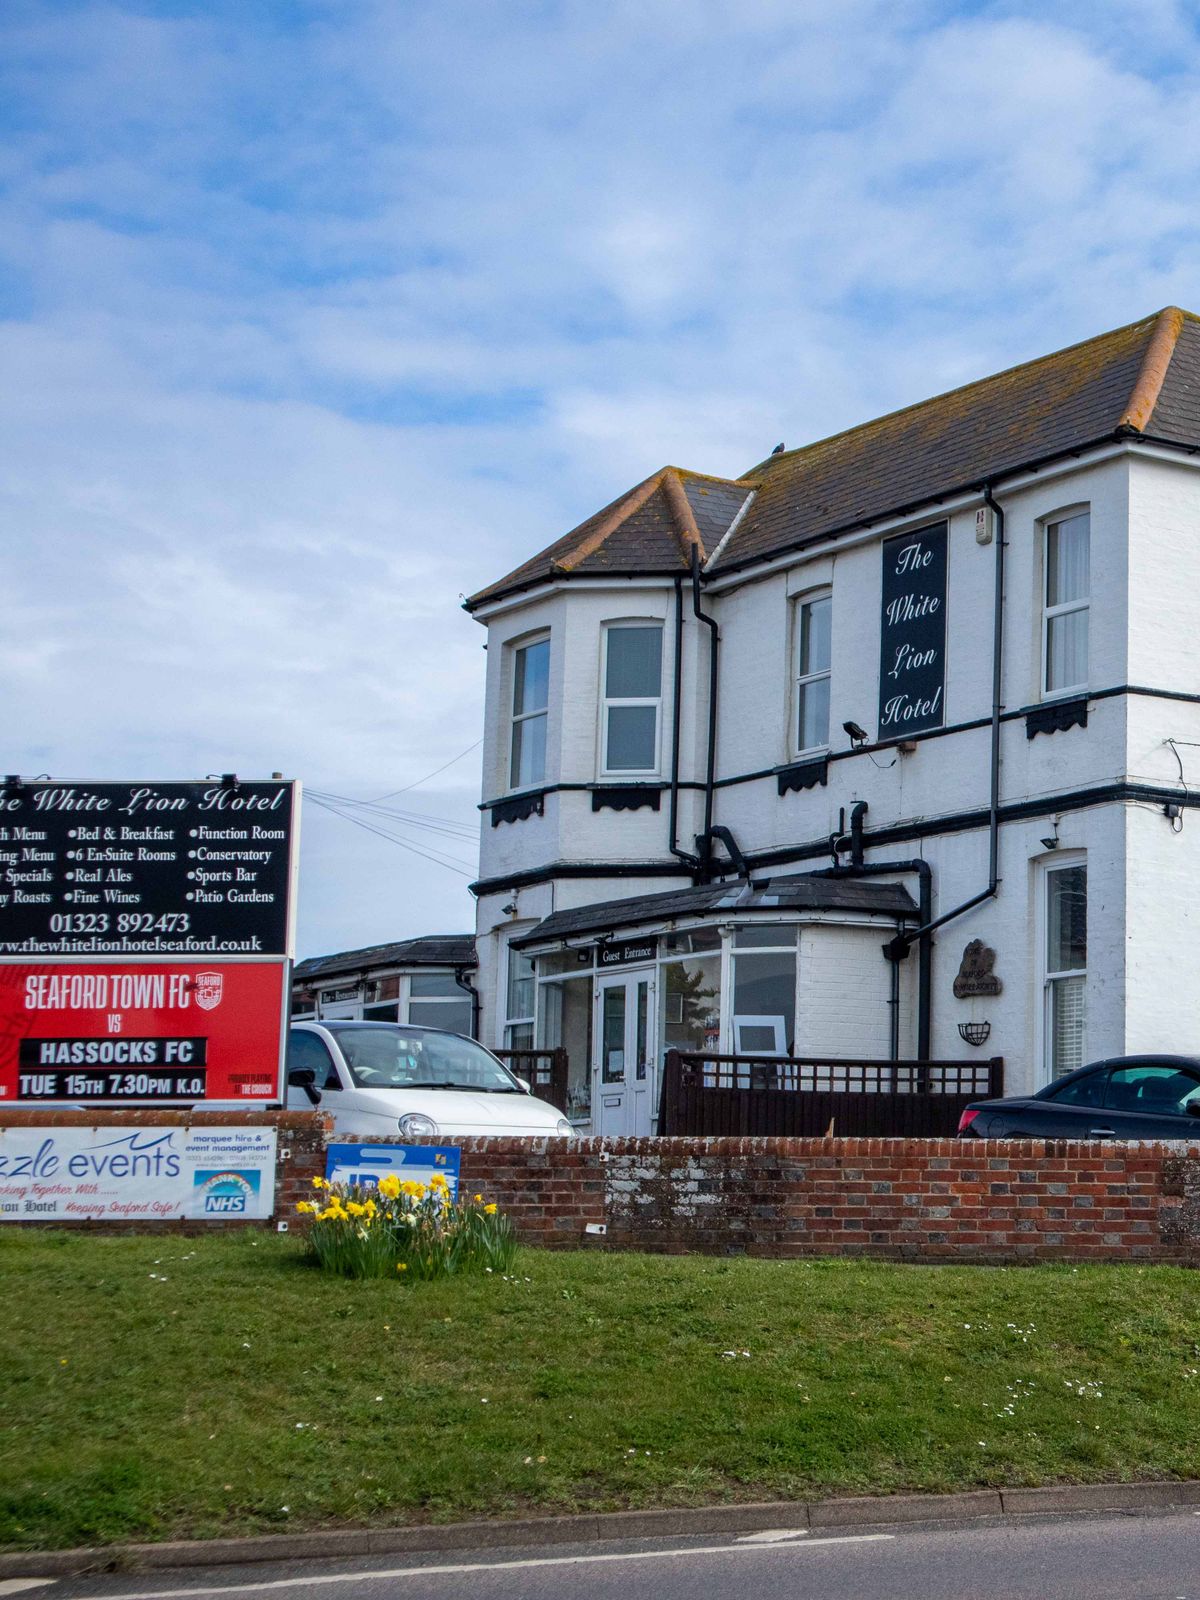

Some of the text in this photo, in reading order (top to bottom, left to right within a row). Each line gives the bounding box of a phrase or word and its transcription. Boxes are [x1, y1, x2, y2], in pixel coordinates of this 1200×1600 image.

[895, 542, 934, 574] The
[886, 594, 941, 626] White
[888, 643, 938, 680] Lion
[881, 686, 942, 726] Hotel
[0, 788, 287, 815] he White Lion Hotel
[13, 826, 47, 840] Menu
[77, 826, 174, 841] Bed & Breakfast
[198, 825, 285, 840] Function Room
[21, 847, 55, 861] Menu
[75, 847, 176, 862] 6 En-Suite Rooms
[197, 846, 272, 864] Conservatory
[6, 868, 52, 886] Specials
[75, 868, 132, 882] Real Ales
[195, 868, 257, 886] Sports Bar
[13, 890, 52, 903] Roasts
[73, 889, 141, 904] Fine Wines
[194, 888, 274, 903] Patio Gardens
[50, 913, 190, 933] 01323 892473
[603, 947, 652, 962] Guest Entrance
[25, 974, 190, 1009] SEAFORD TOWN FC
[107, 1013, 121, 1033] VS
[40, 1041, 193, 1064] HASSOCKS FC
[19, 1074, 57, 1094] TUE
[65, 1074, 105, 1094] 15TH
[109, 1074, 171, 1094] 7.30PM
[176, 1079, 205, 1094] K.O.
[193, 1135, 232, 1144] marquee
[235, 1134, 252, 1142] hire
[212, 1144, 270, 1153] management
[68, 1147, 181, 1178] events
[31, 1183, 72, 1200] Together
[75, 1183, 99, 1194] With
[24, 1200, 57, 1213] Hotel
[65, 1201, 104, 1217] Keeping
[107, 1201, 149, 1216] Seaford
[206, 1196, 244, 1211] NHS
